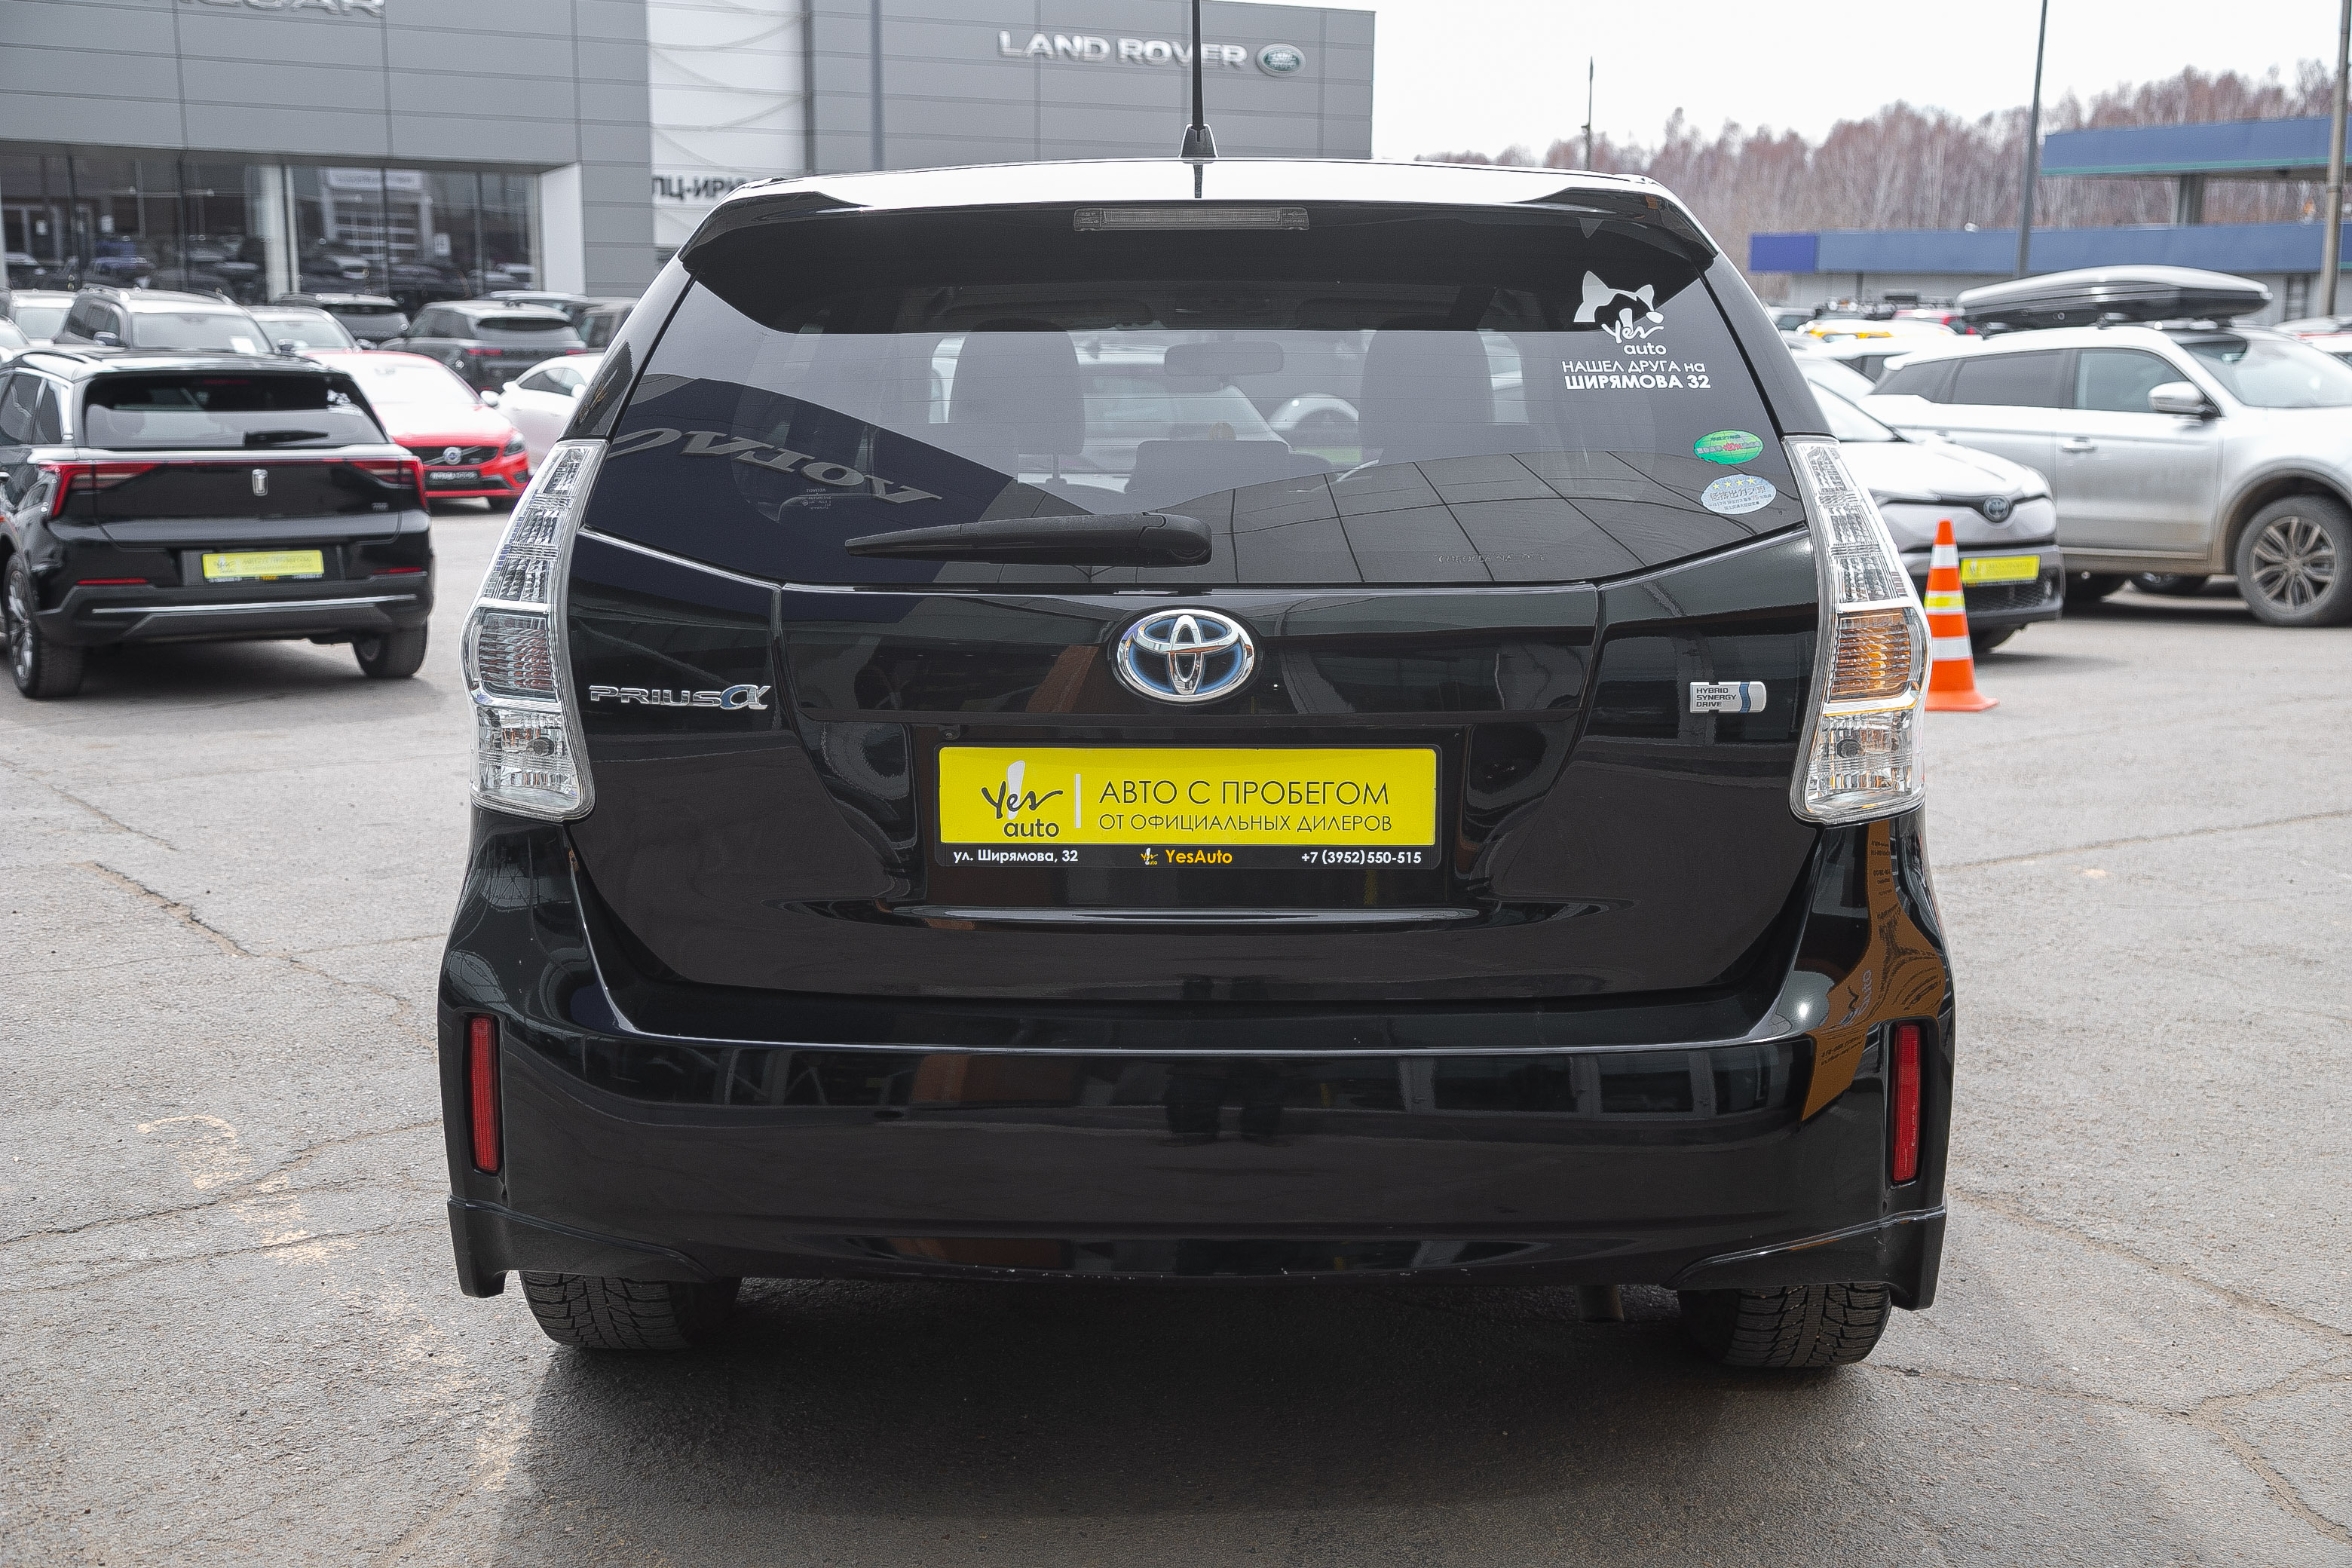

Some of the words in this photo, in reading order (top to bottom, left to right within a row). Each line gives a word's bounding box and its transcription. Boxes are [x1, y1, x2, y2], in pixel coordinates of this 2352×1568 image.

[998, 30, 1111, 63] LAND
[1116, 38, 1248, 70] ROVER
[1623, 341, 1667, 356] auto
[1561, 360, 1625, 373] НАШЕЛ
[1628, 360, 1681, 374] ДРУГА
[1683, 362, 1706, 373] на
[1564, 374, 1683, 390] ШИРЯМОВА
[1687, 375, 1711, 390] 32
[1098, 779, 1178, 805] АВТО
[1187, 780, 1211, 805] С
[1221, 780, 1390, 806] ПРОБЕГОМ
[1003, 819, 1060, 838] auto
[1098, 813, 1125, 831] ОТ
[1130, 813, 1291, 833] ОФИЦИАЛЬНЫХ
[1297, 814, 1392, 833] ДИЛЕРОВ
[953, 850, 974, 864] ул.
[978, 850, 1058, 864] Ширямова,
[1062, 850, 1079, 862] 32
[1165, 849, 1233, 865] YesAuto
[1301, 852, 1319, 864] +7
